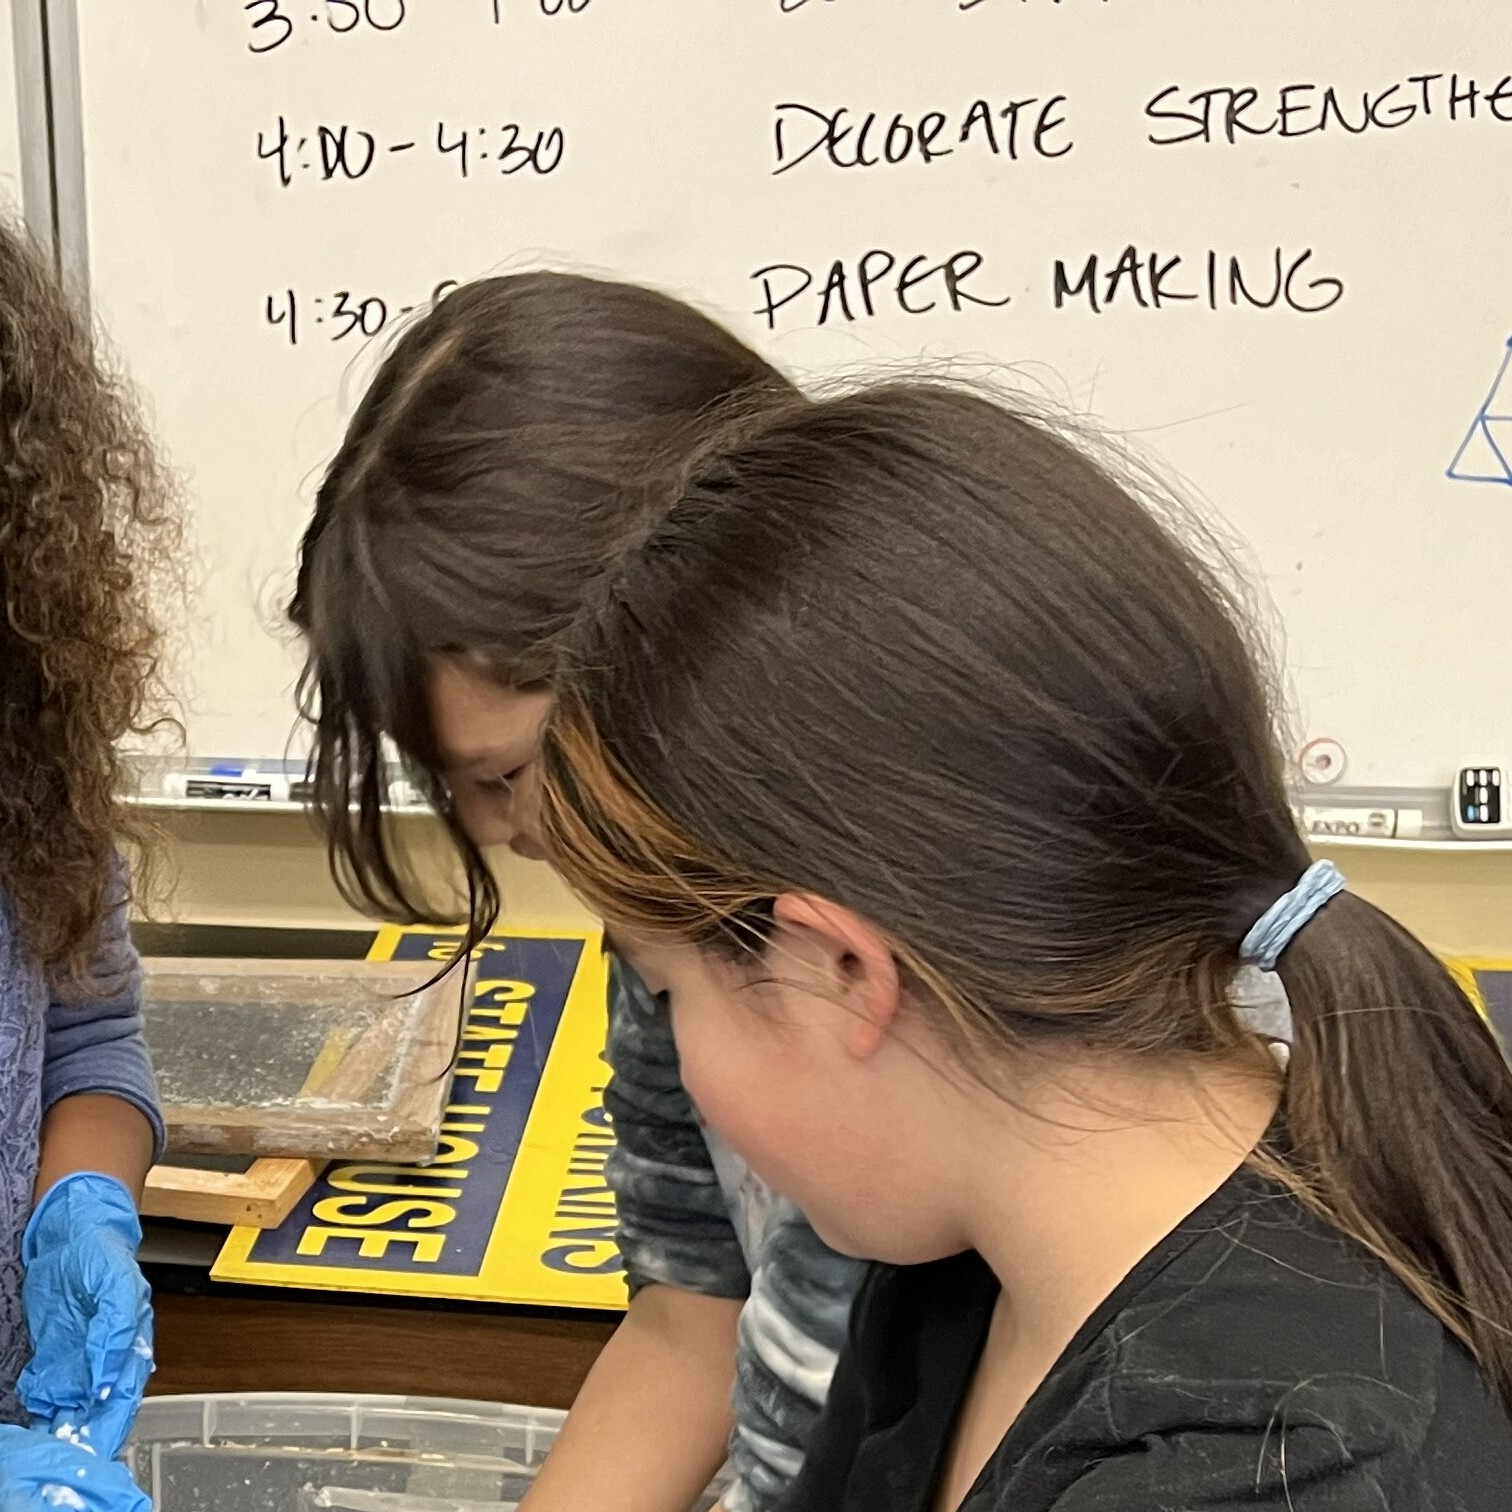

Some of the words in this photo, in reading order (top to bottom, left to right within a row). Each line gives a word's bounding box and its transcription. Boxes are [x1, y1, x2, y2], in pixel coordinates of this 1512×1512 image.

[772, 95, 1074, 175] DECORATE
[750, 250, 1011, 329] PAPER
[1054, 245, 1344, 314] MAKING
